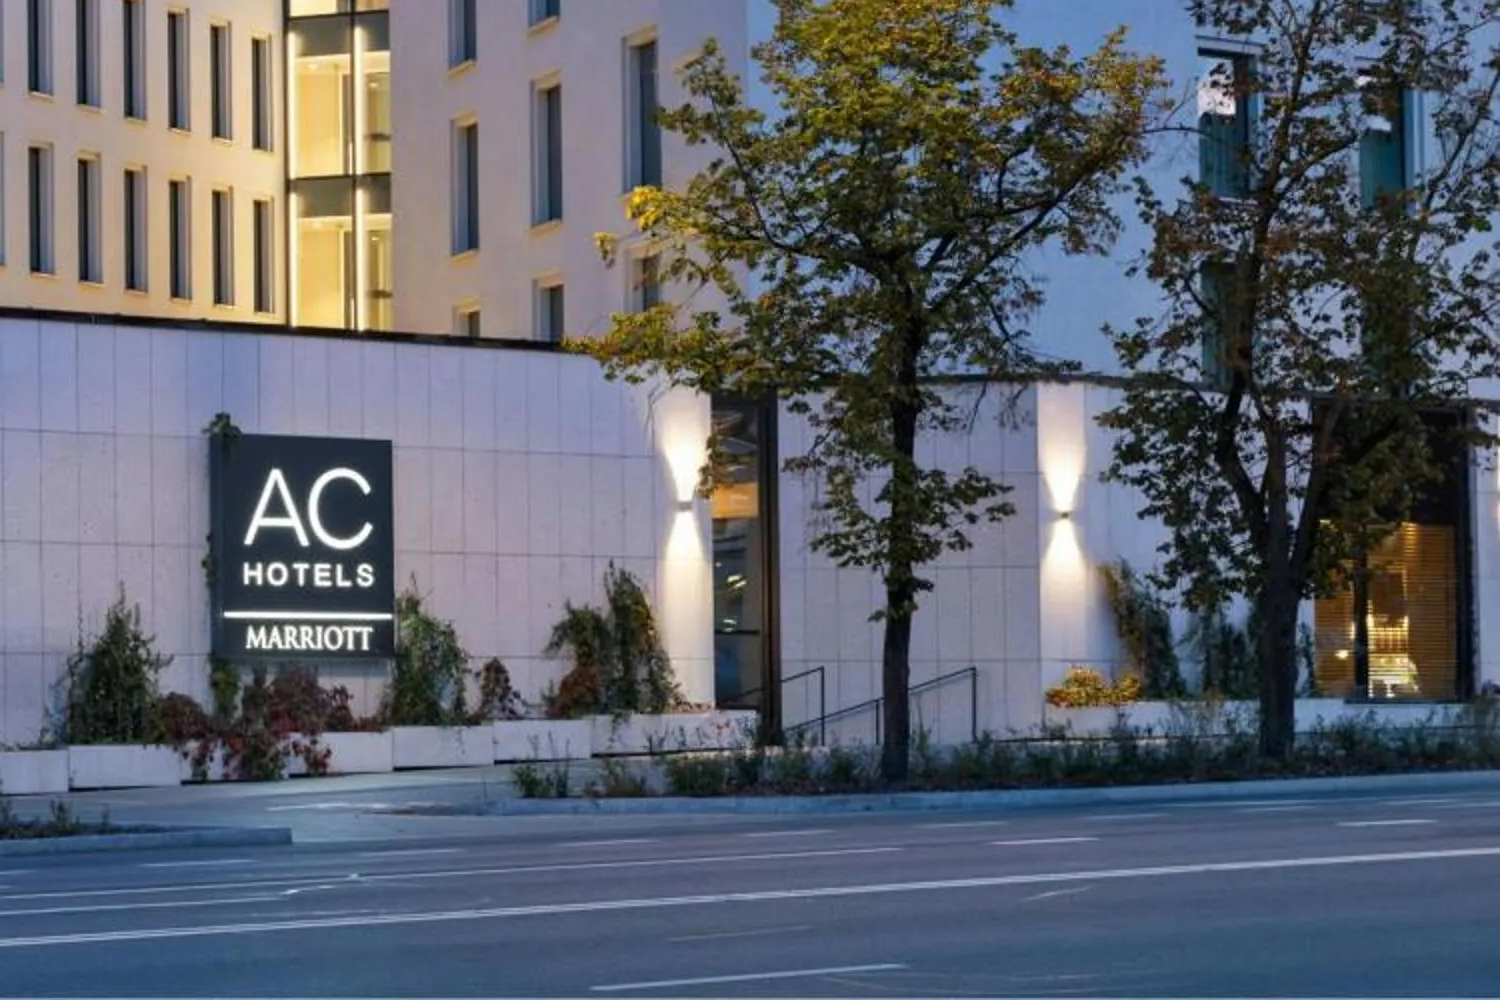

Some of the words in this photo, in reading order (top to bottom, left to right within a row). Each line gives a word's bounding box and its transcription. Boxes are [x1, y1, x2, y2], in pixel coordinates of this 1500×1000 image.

[243, 467, 373, 550] AC
[243, 561, 375, 588] HOTELS
[245, 625, 374, 651] MARRIOTT
